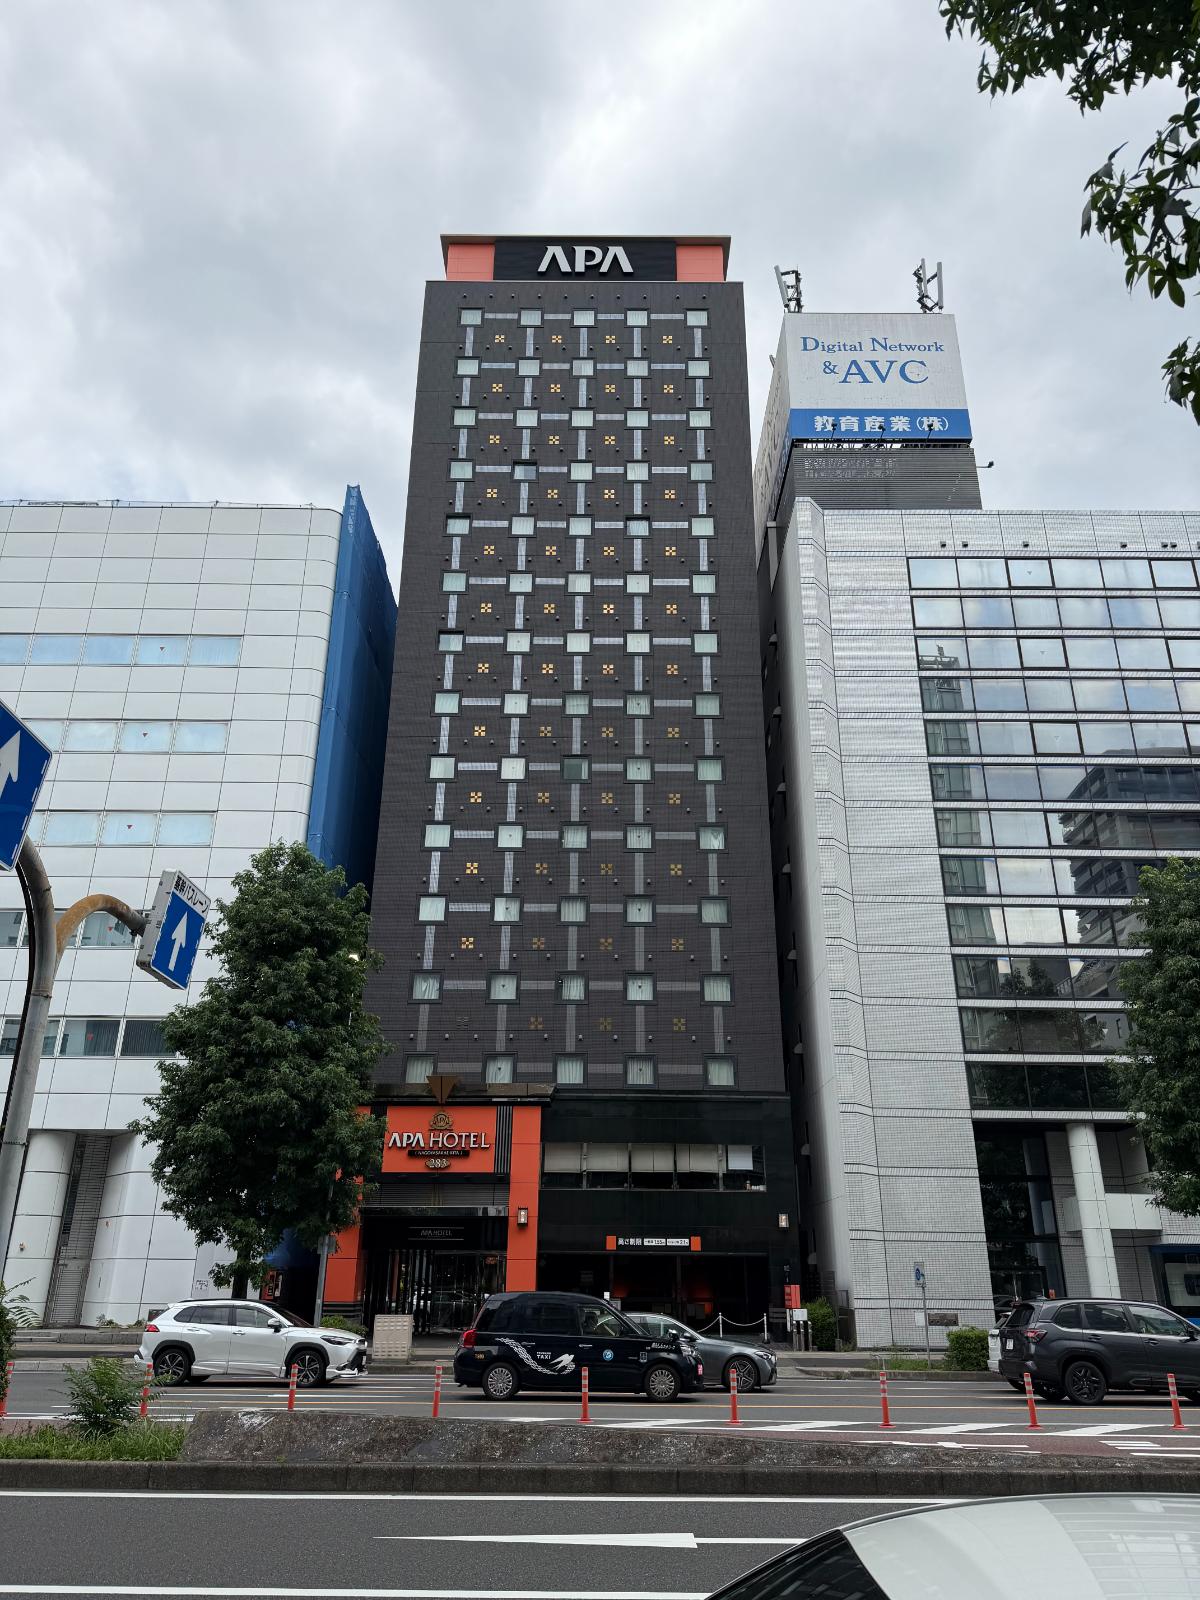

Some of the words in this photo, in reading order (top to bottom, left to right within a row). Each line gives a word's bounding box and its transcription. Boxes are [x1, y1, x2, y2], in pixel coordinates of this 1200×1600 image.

[537, 245, 634, 273] APA
[800, 336, 863, 354] Digital
[870, 337, 944, 352] Network
[388, 1132, 425, 1148] APA
[429, 1132, 490, 1148] HOTEL
[429, 1158, 447, 1168] 283
